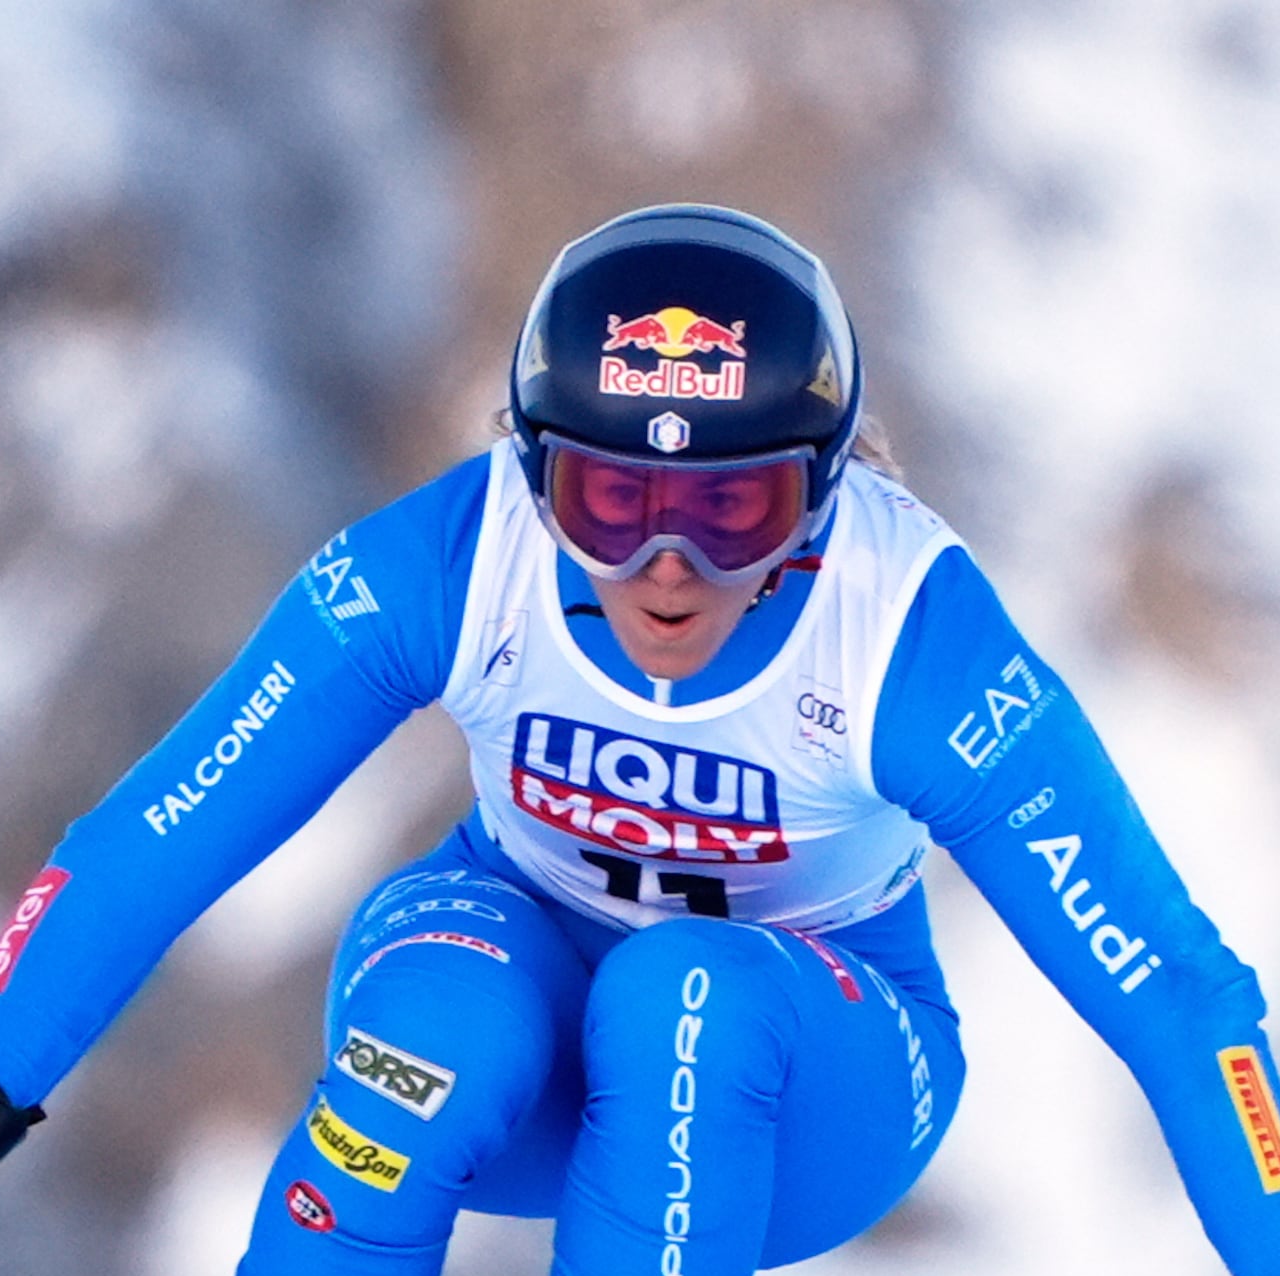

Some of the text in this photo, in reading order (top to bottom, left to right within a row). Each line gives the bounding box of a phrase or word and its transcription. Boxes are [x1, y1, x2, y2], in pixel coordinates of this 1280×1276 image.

[599, 356, 745, 400] Red Bull
[143, 660, 297, 836] FALCONERI
[947, 653, 1043, 769] EA7
[521, 774, 778, 861] MOLY
[524, 718, 766, 822] LIQUI
[1026, 834, 1162, 995] Audi
[336, 1036, 447, 1107] FORST
